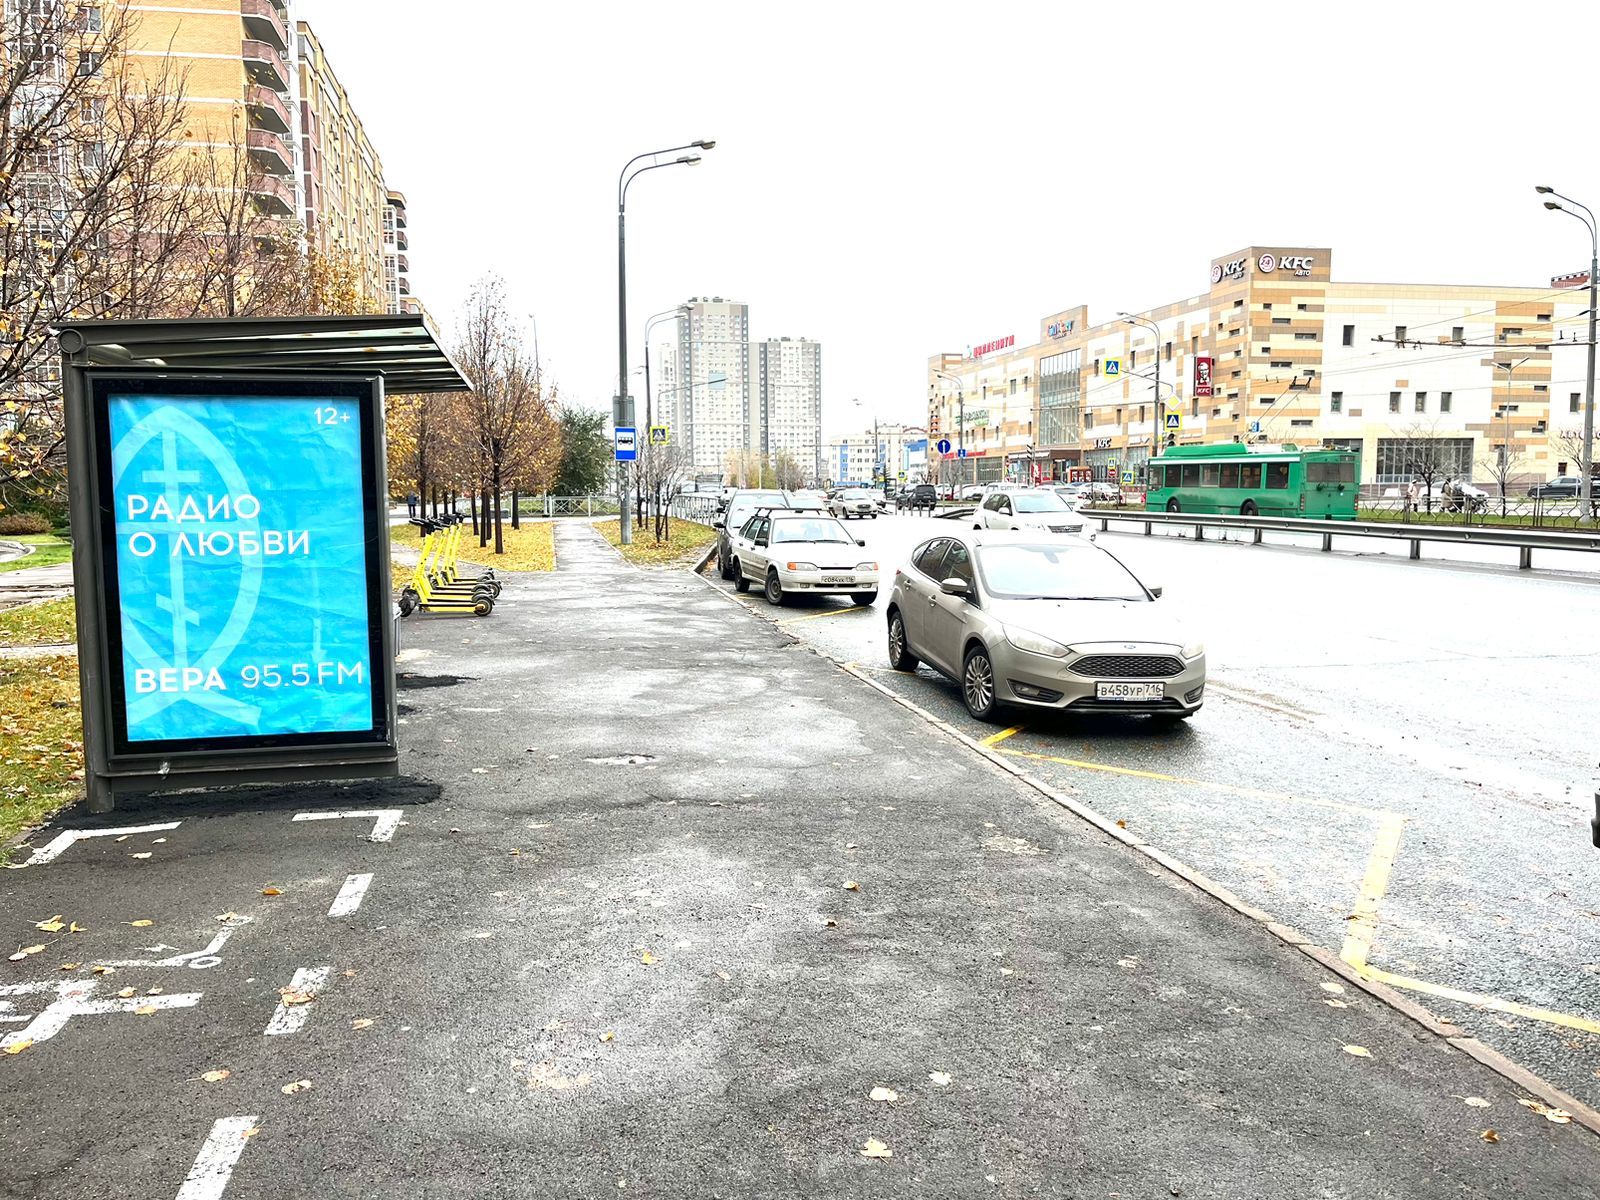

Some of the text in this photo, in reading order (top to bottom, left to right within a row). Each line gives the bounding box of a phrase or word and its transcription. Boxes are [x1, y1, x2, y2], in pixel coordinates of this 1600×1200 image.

[1223, 258, 1246, 277] KFC
[1278, 256, 1314, 270] KFC
[314, 407, 350, 424] 12+
[1098, 438, 1112, 449] KFC
[126, 493, 261, 524] РАДИО
[128, 529, 311, 557] О ЛЮБВИ
[134, 660, 363, 693] ВЕРА 95.5 FM
[1101, 684, 1161, 696] В458УР 716
